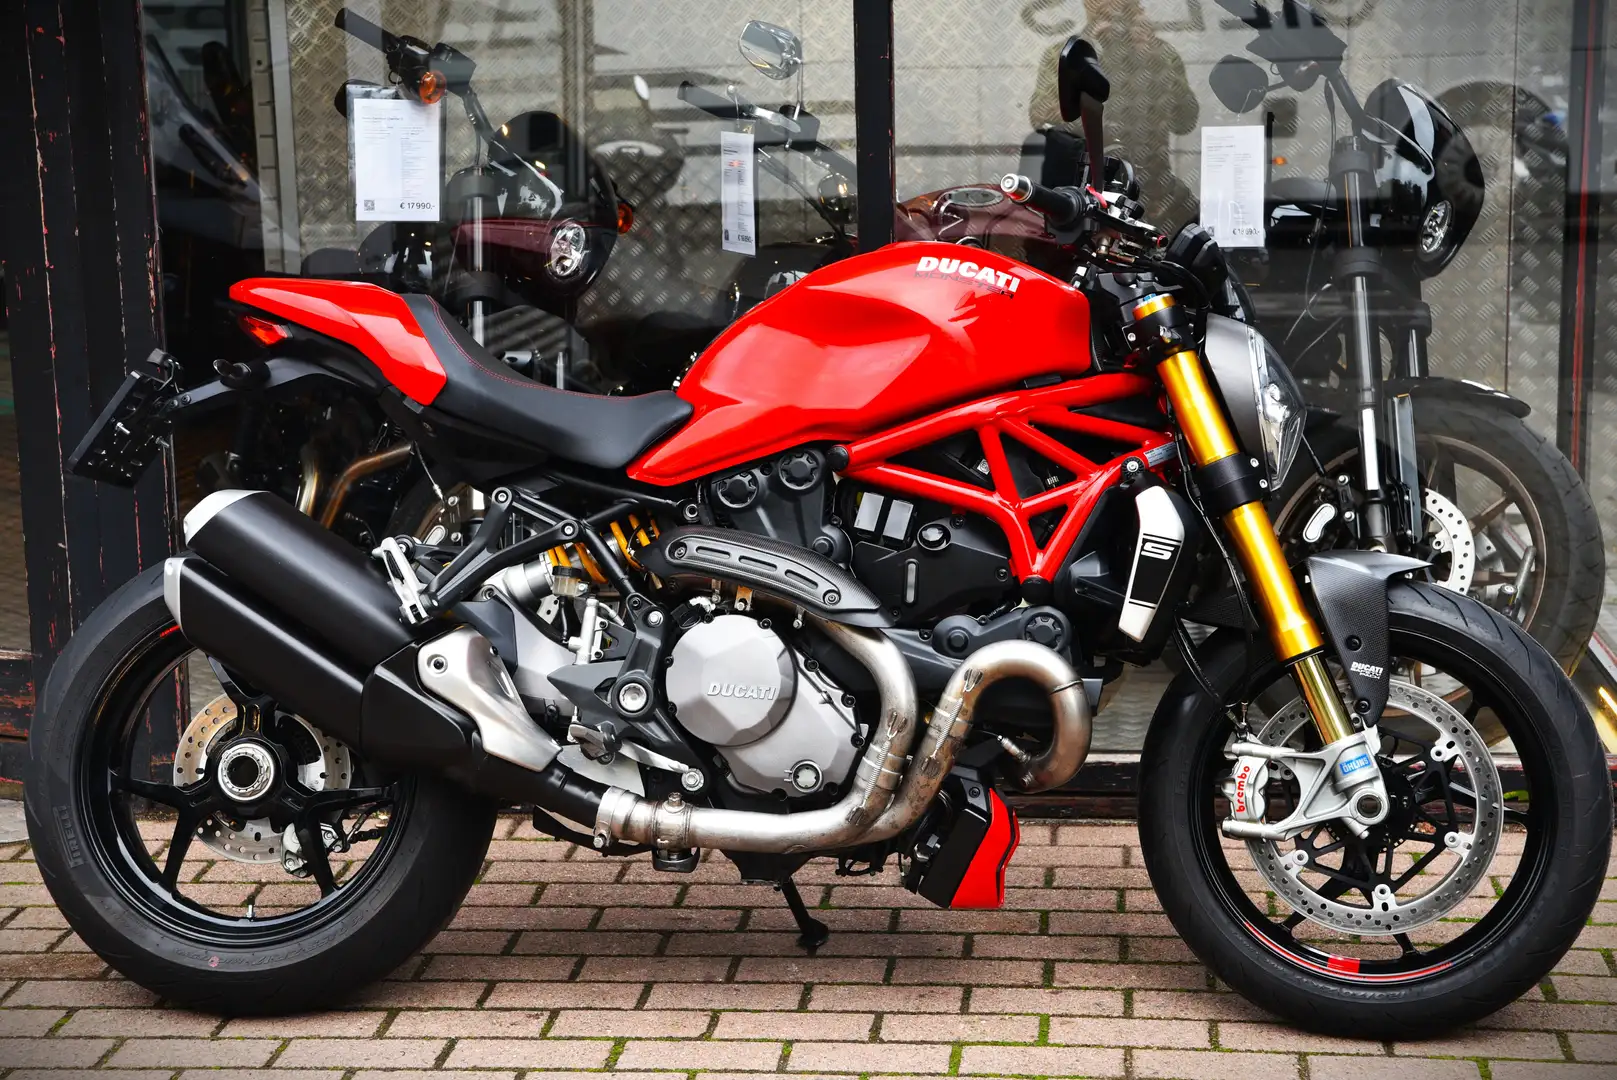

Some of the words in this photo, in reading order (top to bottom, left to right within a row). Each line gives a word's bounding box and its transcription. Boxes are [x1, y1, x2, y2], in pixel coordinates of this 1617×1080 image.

[916, 256, 1021, 293] DUCATI
[1351, 661, 1384, 674] DUCATI
[707, 682, 776, 700] DUCATI
[1236, 765, 1251, 813] brembo
